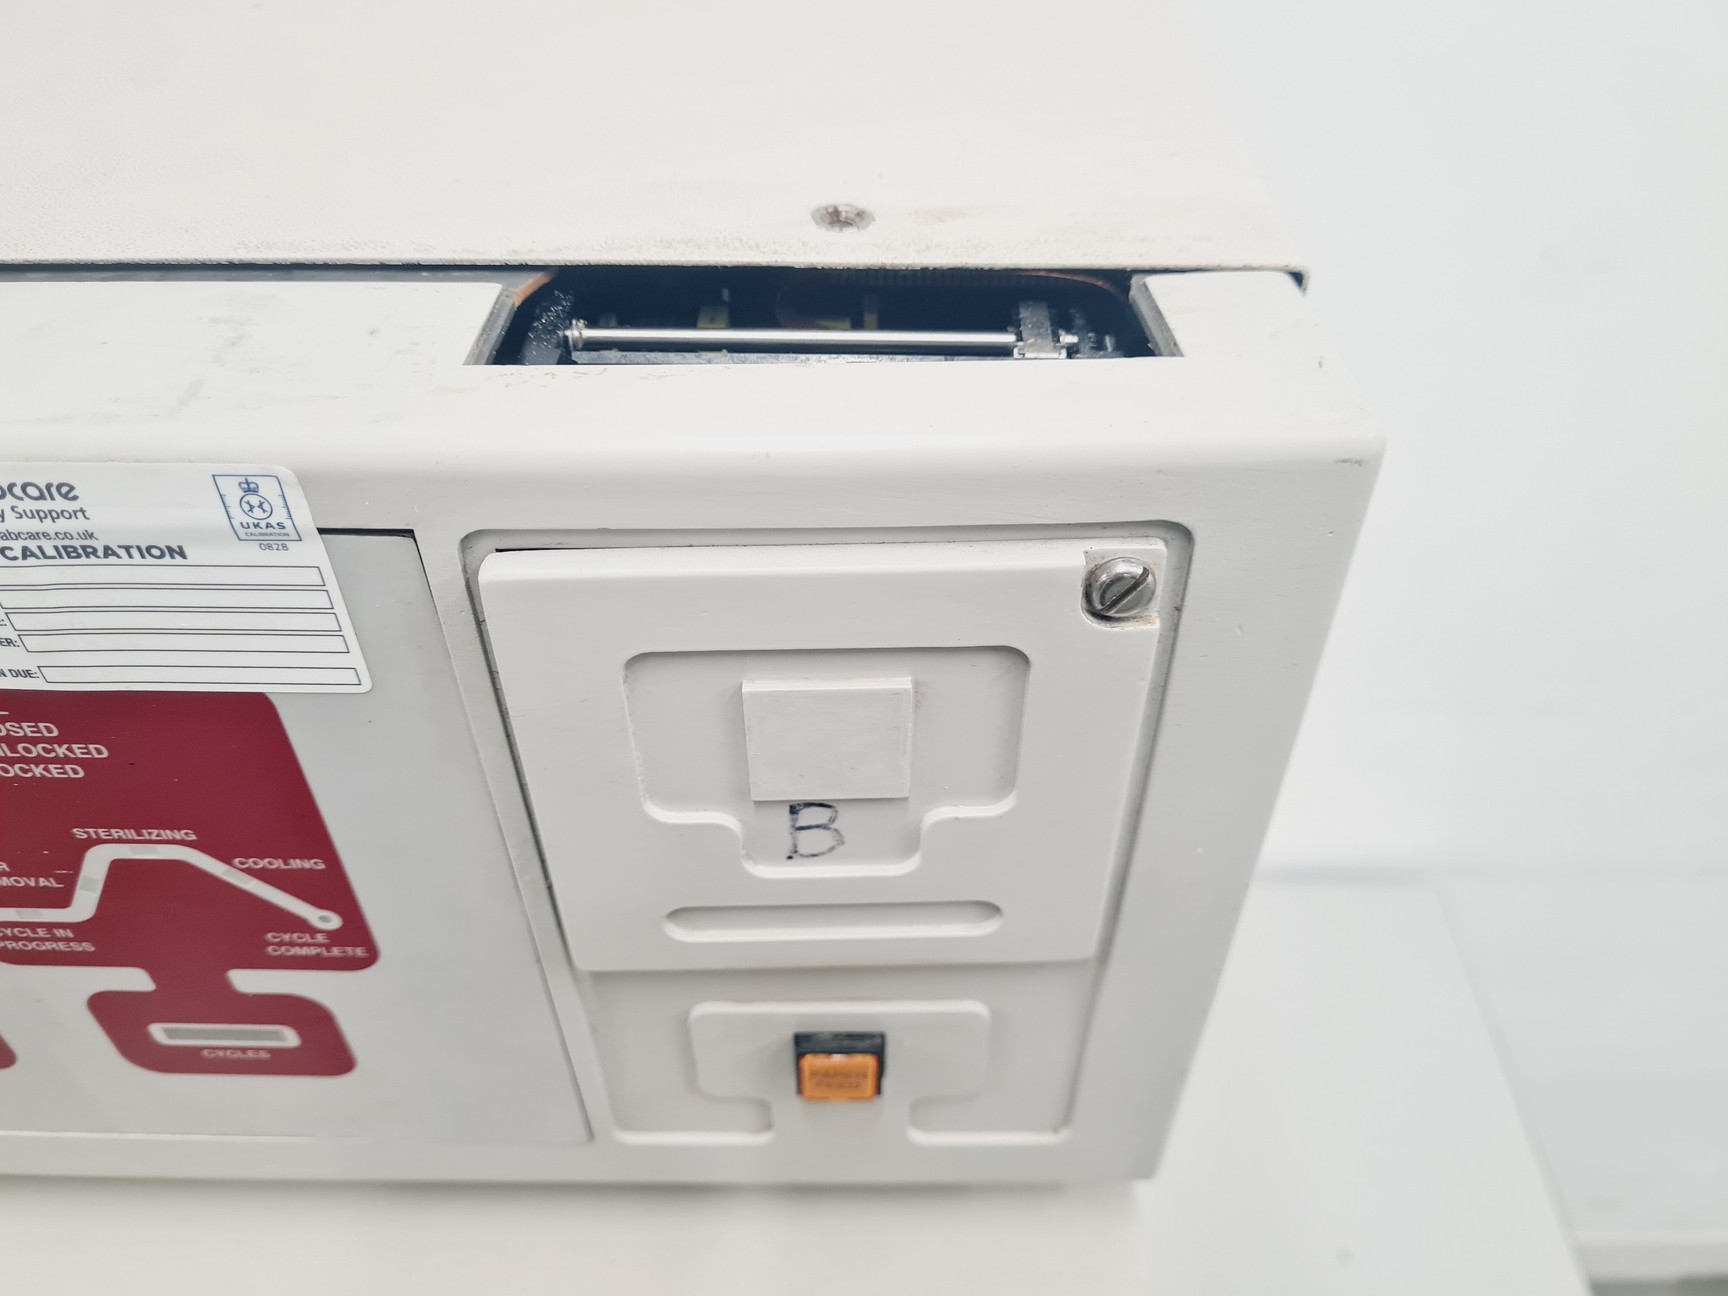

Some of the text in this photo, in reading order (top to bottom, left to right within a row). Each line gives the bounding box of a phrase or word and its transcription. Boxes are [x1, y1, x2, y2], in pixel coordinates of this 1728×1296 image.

[10, 505, 90, 523] Support
[240, 521, 286, 530] UKAS
[259, 542, 289, 551] 0828
[0, 544, 188, 561] CALIBRATION
[8, 669, 40, 678] DUE:
[72, 828, 198, 841] STERILIZING
[787, 802, 845, 860] B
[232, 857, 327, 870] COOLING
[53, 928, 74, 938] IN
[265, 932, 330, 943] CYCLE
[266, 946, 369, 957] COMPLETE
